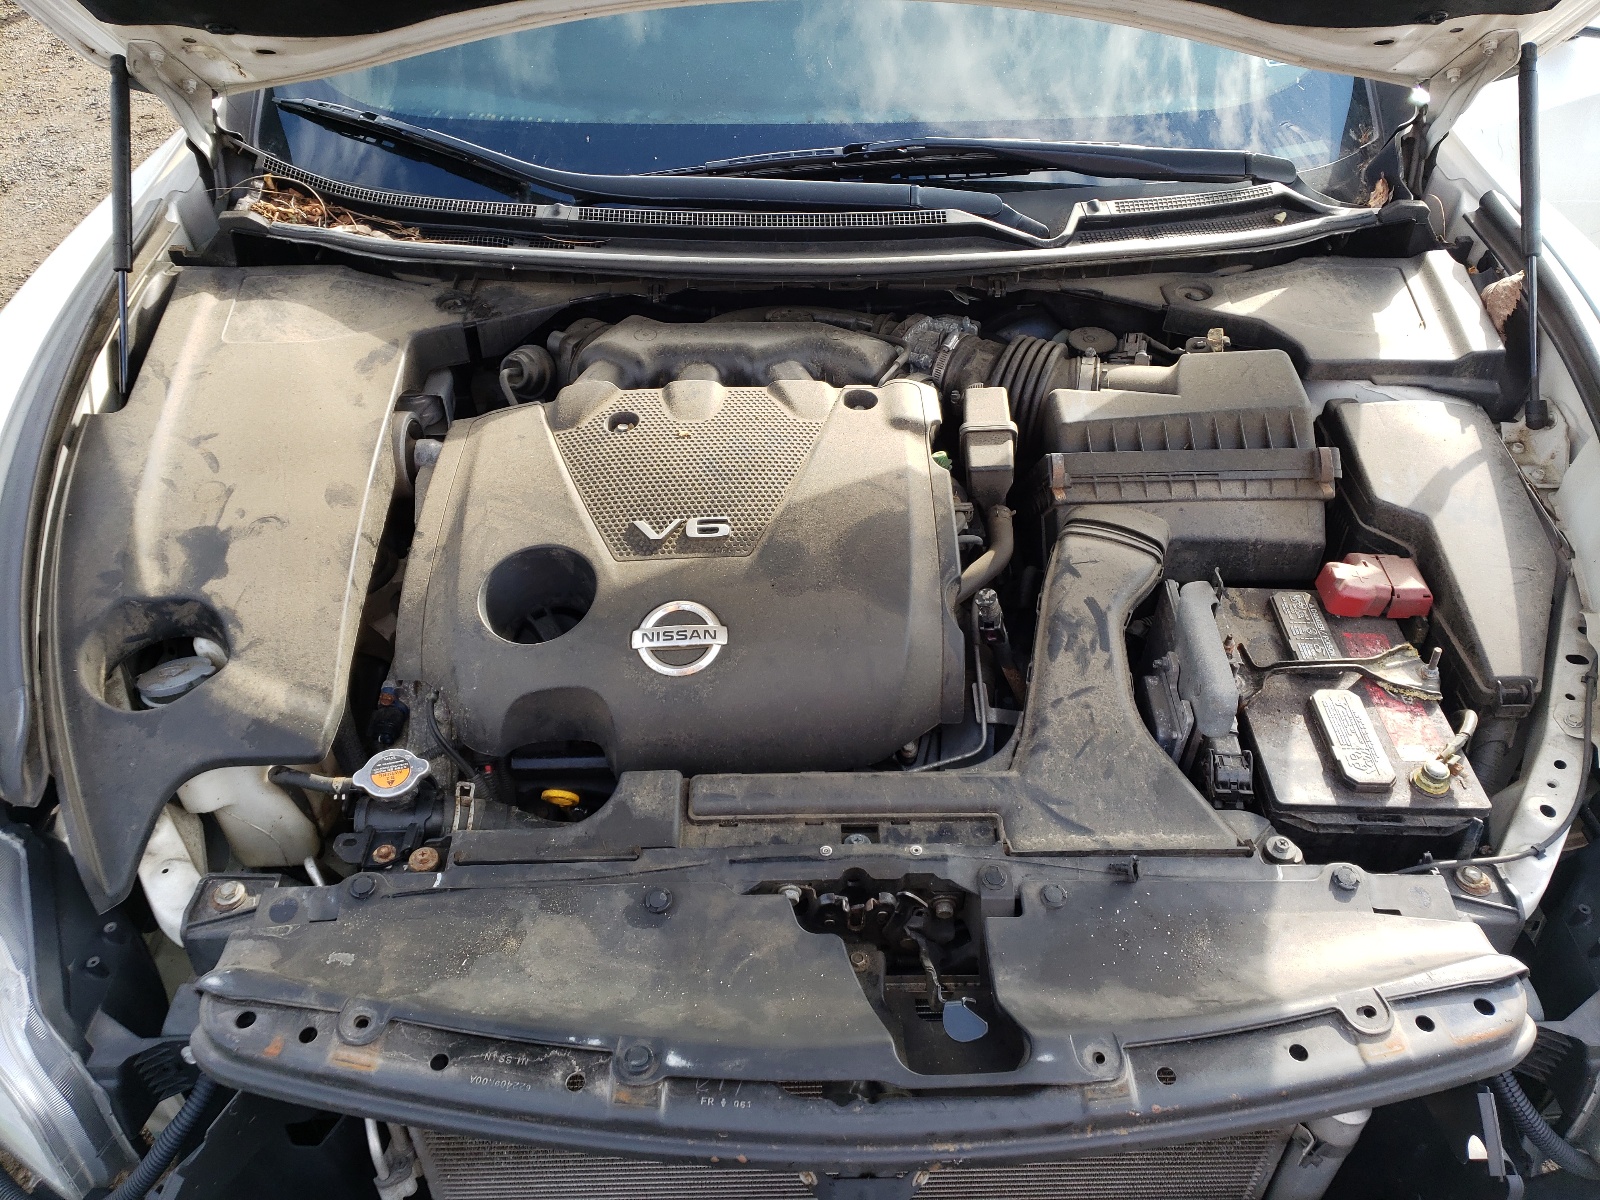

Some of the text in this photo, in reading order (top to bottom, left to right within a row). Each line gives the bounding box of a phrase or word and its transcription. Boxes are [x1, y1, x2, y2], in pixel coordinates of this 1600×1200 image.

[632, 517, 731, 540] V6
[1311, 608, 1326, 631] DANGER
[641, 629, 717, 644] NISSAN
[700, 1096, 715, 1106] FR
